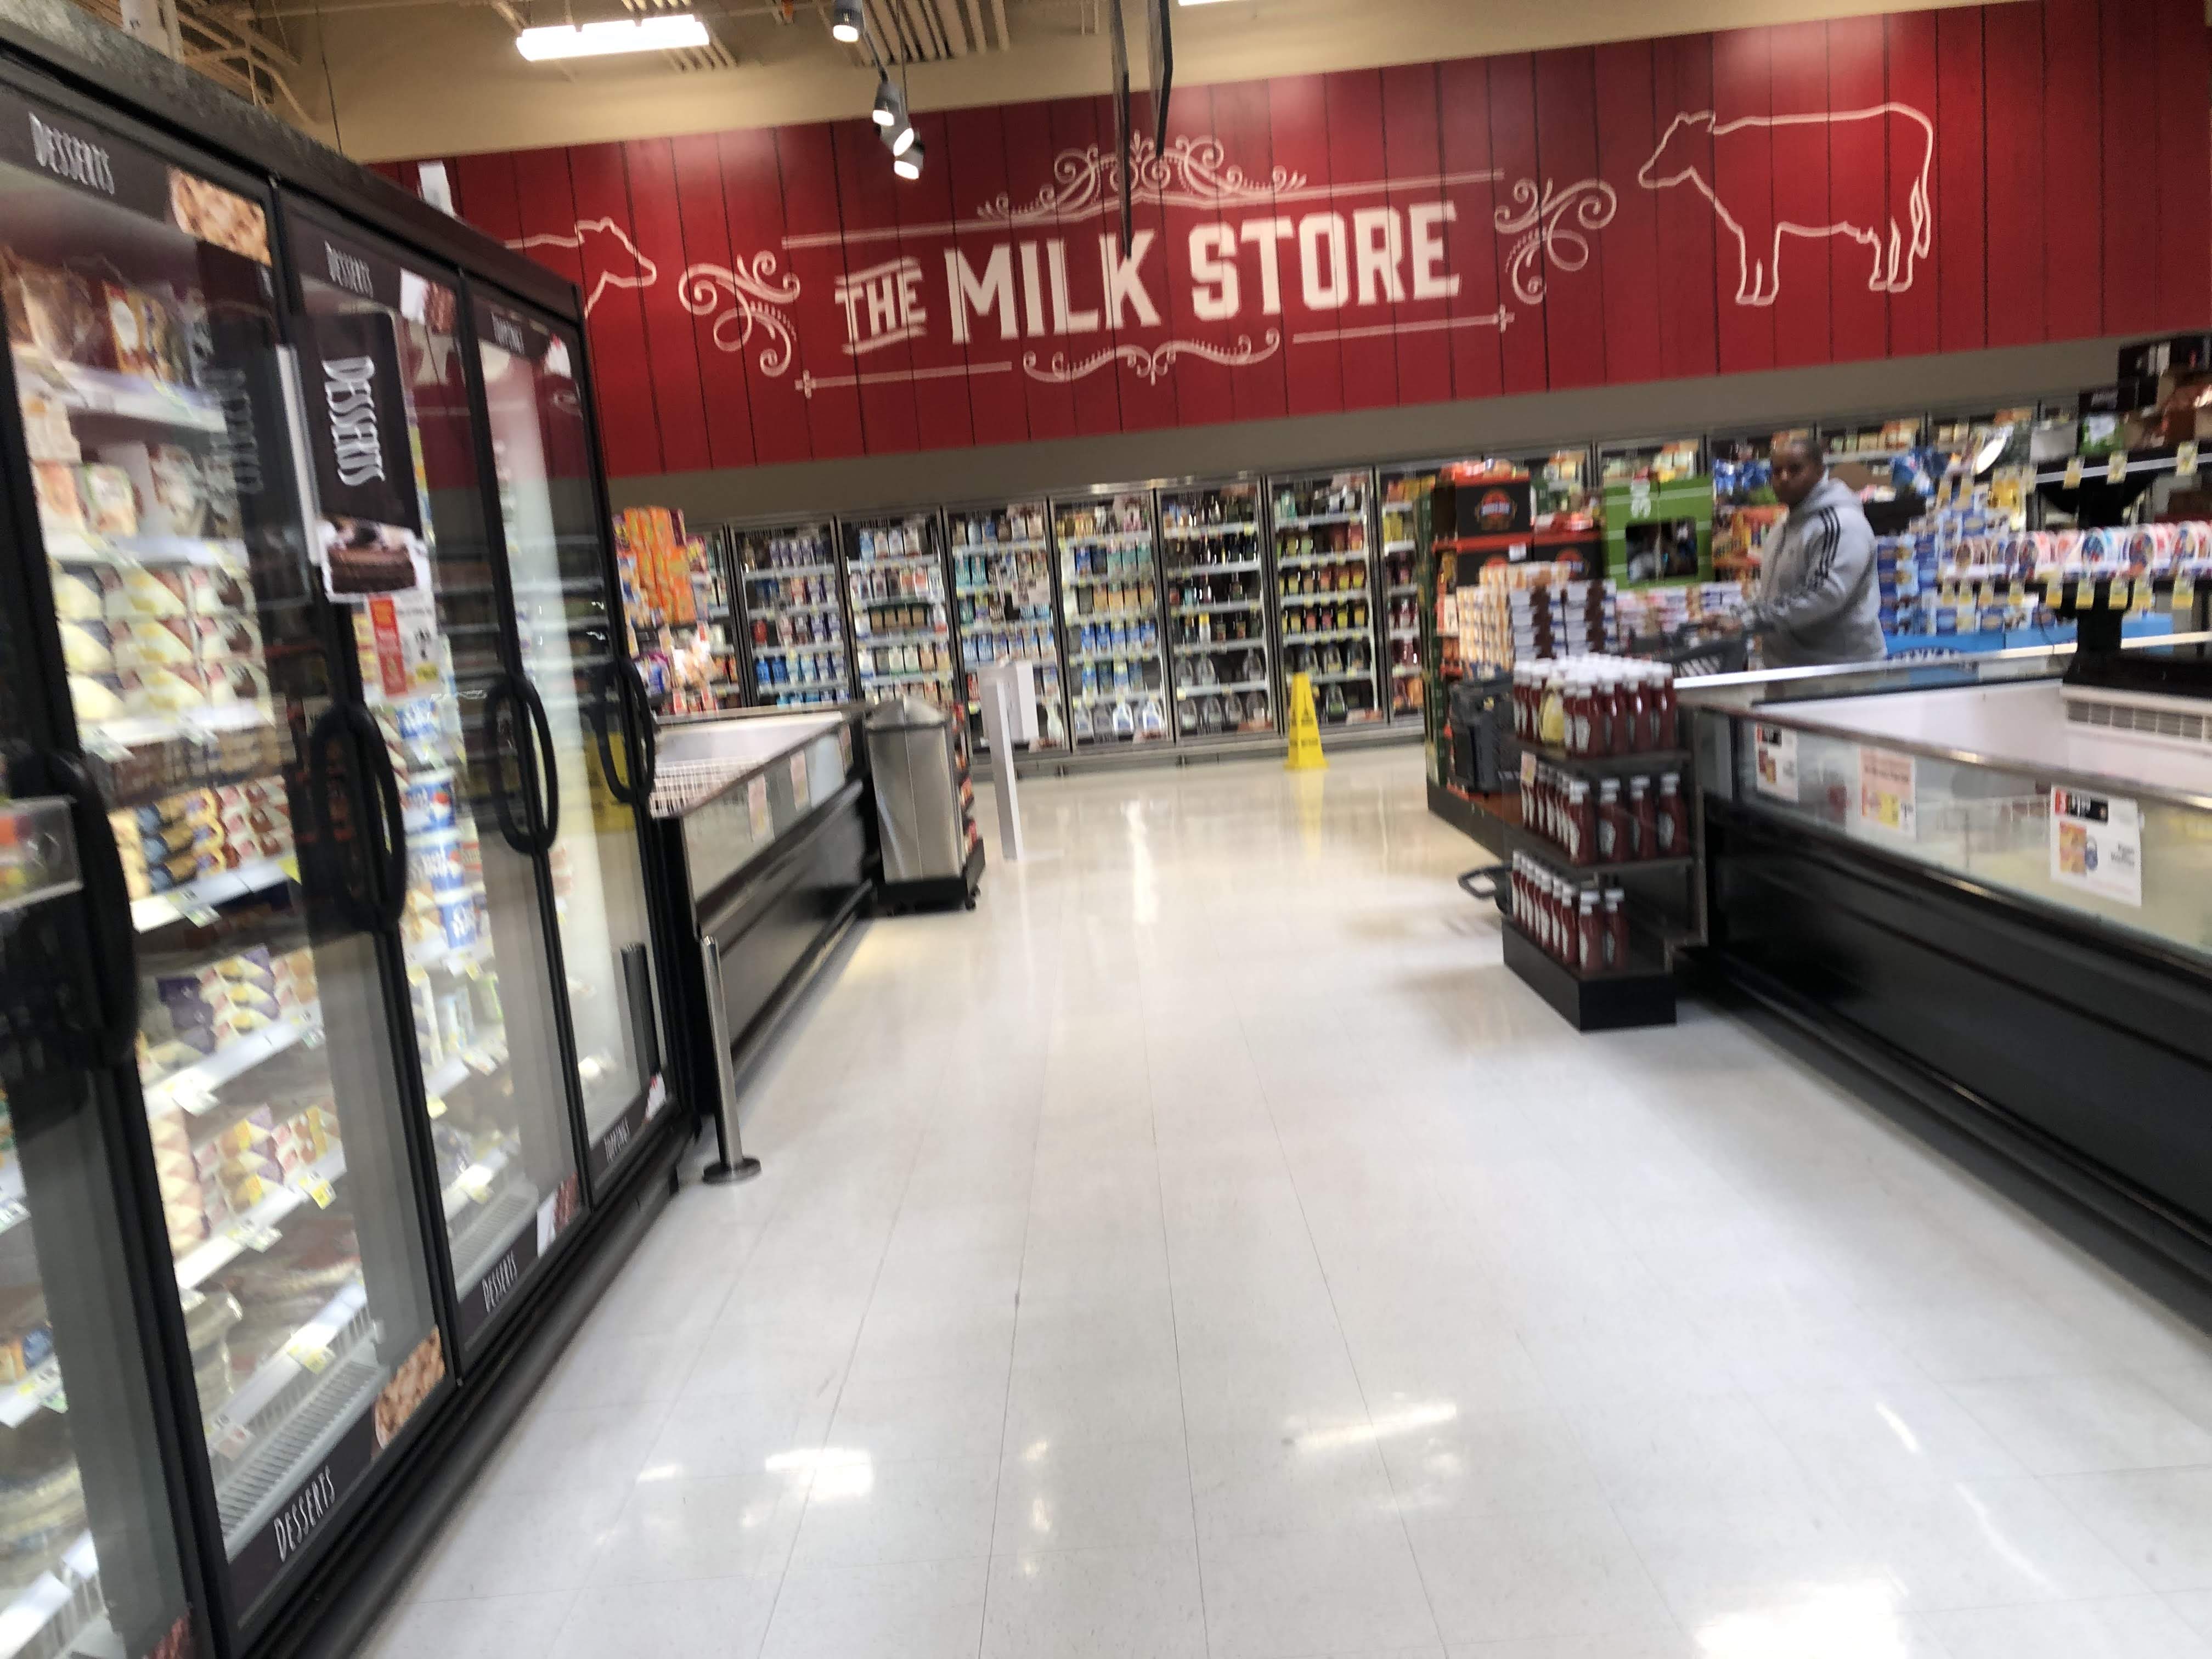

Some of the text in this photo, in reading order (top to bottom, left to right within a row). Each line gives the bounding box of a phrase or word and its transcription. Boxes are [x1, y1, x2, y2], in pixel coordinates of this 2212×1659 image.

[28, 111, 115, 194] DESSERTS
[834, 200, 1460, 344] THE MILK STORE
[321, 356, 385, 486] DESSERTS
[482, 1250, 518, 1312] DESSERTS
[274, 1465, 335, 1562] DESSERTS
